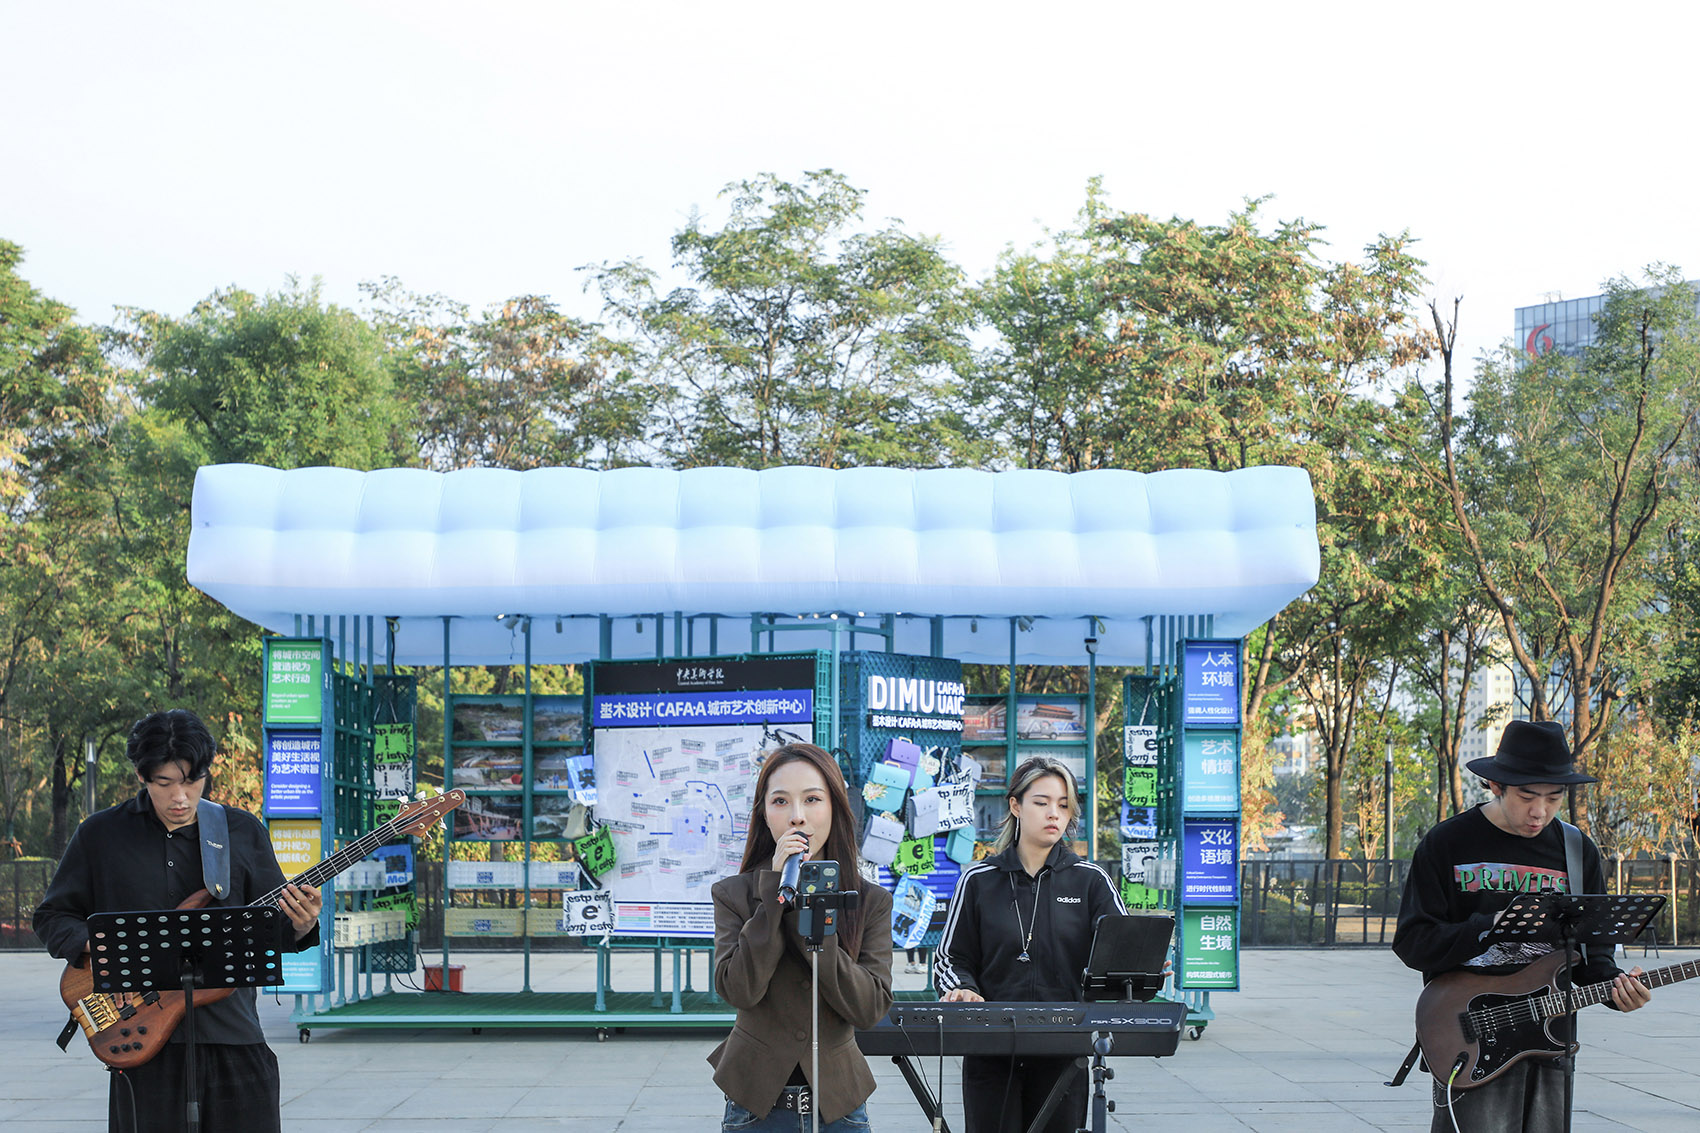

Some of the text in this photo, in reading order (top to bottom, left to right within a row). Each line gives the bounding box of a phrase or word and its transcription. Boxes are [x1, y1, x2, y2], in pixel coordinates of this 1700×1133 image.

[1201, 651, 1234, 668] 人本
[1201, 671, 1235, 687] 环境
[872, 675, 935, 714] DIMU
[938, 695, 965, 715] UAIC
[1201, 739, 1233, 755] 艺术
[271, 752, 320, 762] 美好生活视
[1201, 759, 1234, 775] 情境
[1200, 829, 1232, 845] 文化
[1200, 849, 1233, 864] 语境
[1458, 868, 1570, 894] PRIMUS
[1200, 915, 1232, 931] 自然
[1200, 935, 1233, 950] 生境
